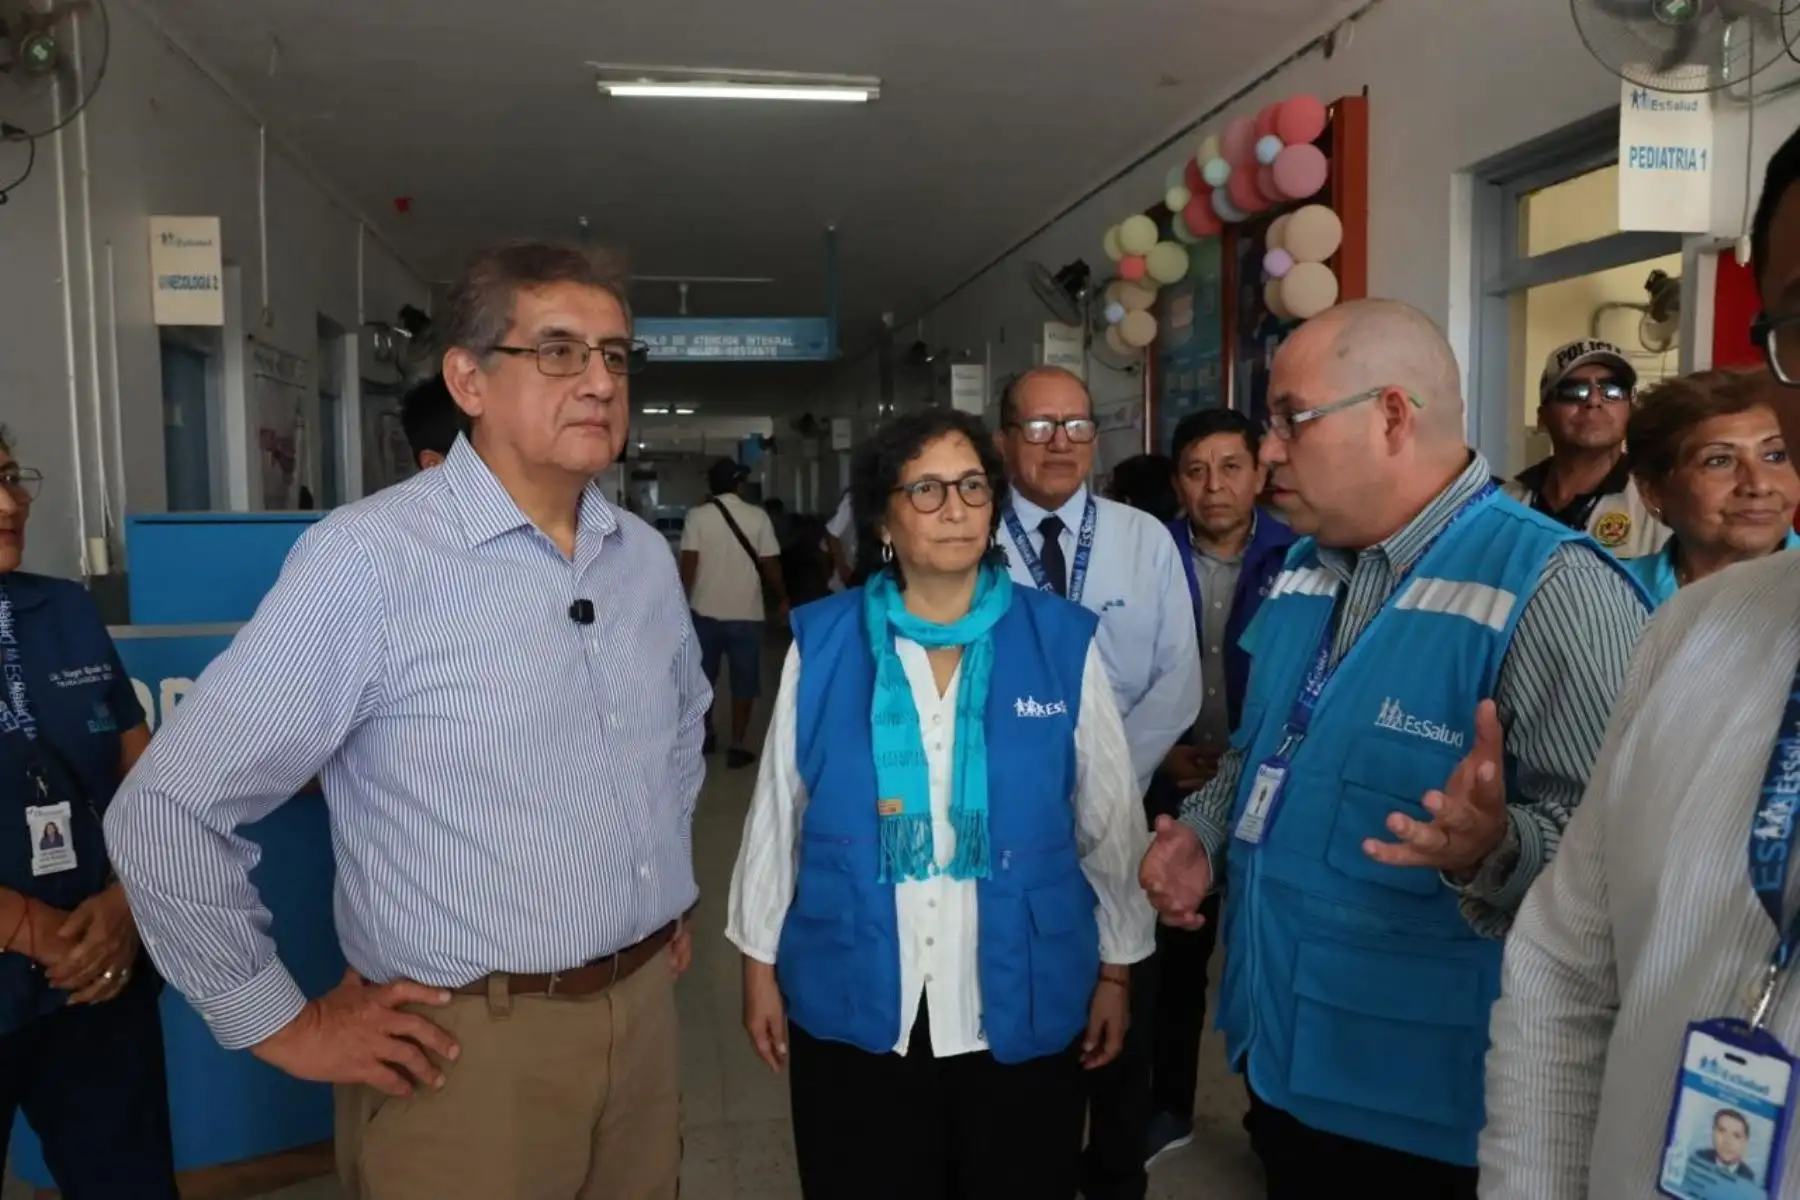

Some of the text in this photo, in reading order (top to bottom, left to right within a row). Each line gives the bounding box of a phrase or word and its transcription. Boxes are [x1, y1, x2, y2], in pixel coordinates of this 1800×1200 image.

[1651, 99, 1699, 112] EsSalud
[1629, 145, 1707, 171] PEDIATRIA 1
[1404, 714, 1464, 748] EsSalud
